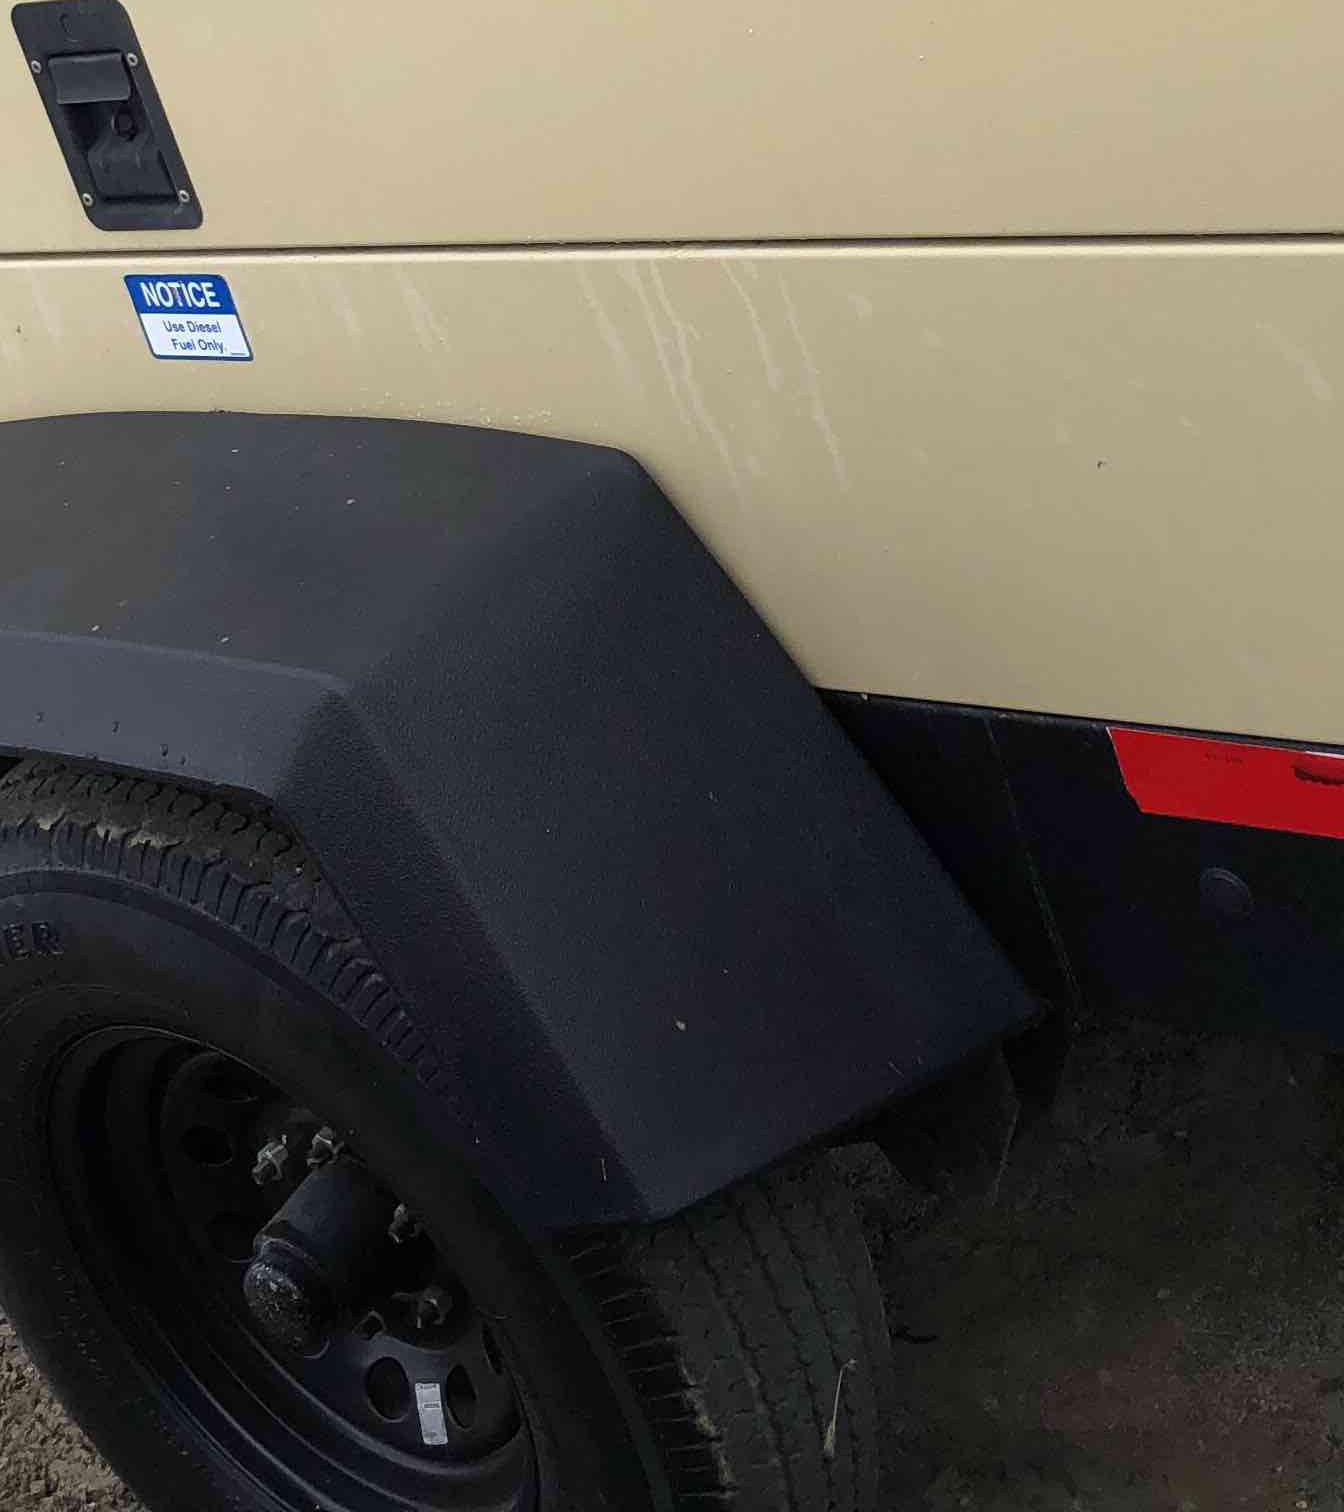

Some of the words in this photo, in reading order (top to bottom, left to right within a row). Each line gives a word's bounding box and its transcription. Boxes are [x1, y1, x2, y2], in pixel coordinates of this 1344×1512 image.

[140, 281, 221, 308] NOTICE
[163, 320, 186, 333] Use
[186, 320, 222, 333] Diesel
[171, 338, 197, 351] Fuel
